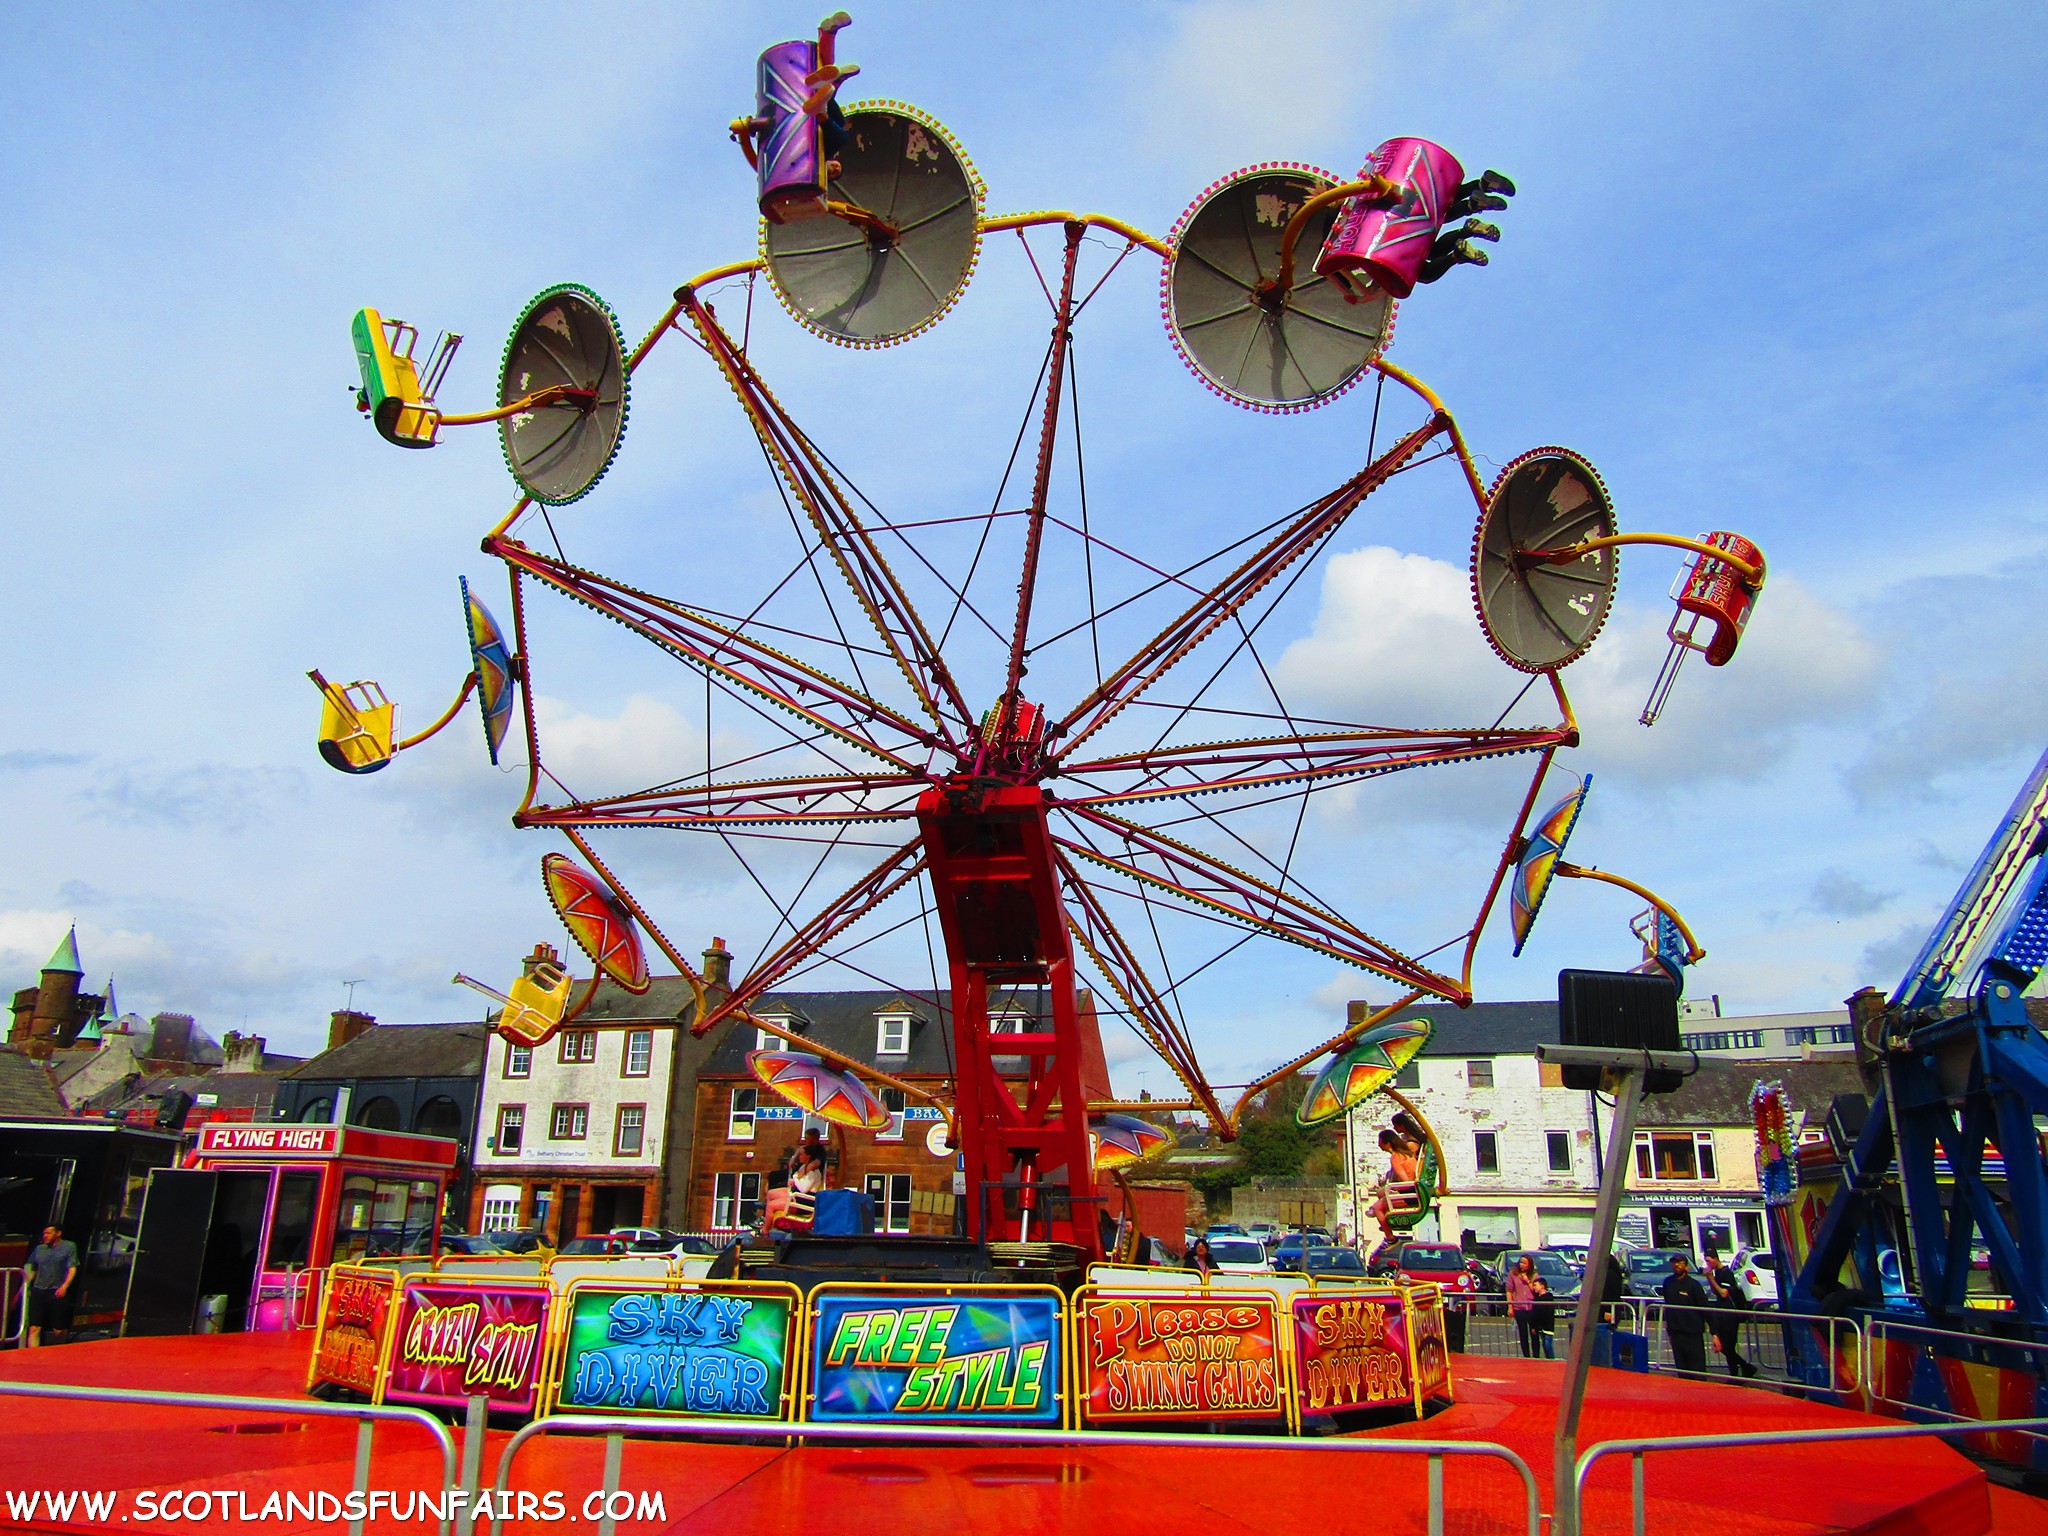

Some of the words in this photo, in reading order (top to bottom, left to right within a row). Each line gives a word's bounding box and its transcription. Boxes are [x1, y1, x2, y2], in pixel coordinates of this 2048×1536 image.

[1708, 574, 1736, 610] SKY
[763, 1108, 793, 1118] THE
[211, 1130, 275, 1149] FLYING
[279, 1131, 326, 1150] HIGH
[1645, 1195, 1708, 1203] WATERFRONT
[1710, 1196, 1747, 1204] Takeaway
[608, 1292, 753, 1342] SKY
[825, 1304, 961, 1367] FREE
[1090, 1300, 1261, 1367] Please
[1315, 1301, 1386, 1346] SKY
[404, 1302, 480, 1364] CRAZY
[465, 1322, 539, 1390] SPIN
[1164, 1336, 1198, 1362] DO
[1199, 1334, 1241, 1361] NOT
[573, 1352, 770, 1414] DIVER
[894, 1340, 1050, 1412] STYLE
[1109, 1358, 1199, 1411] SWING
[1204, 1357, 1276, 1410] CARS
[1306, 1351, 1407, 1409] DIVER
